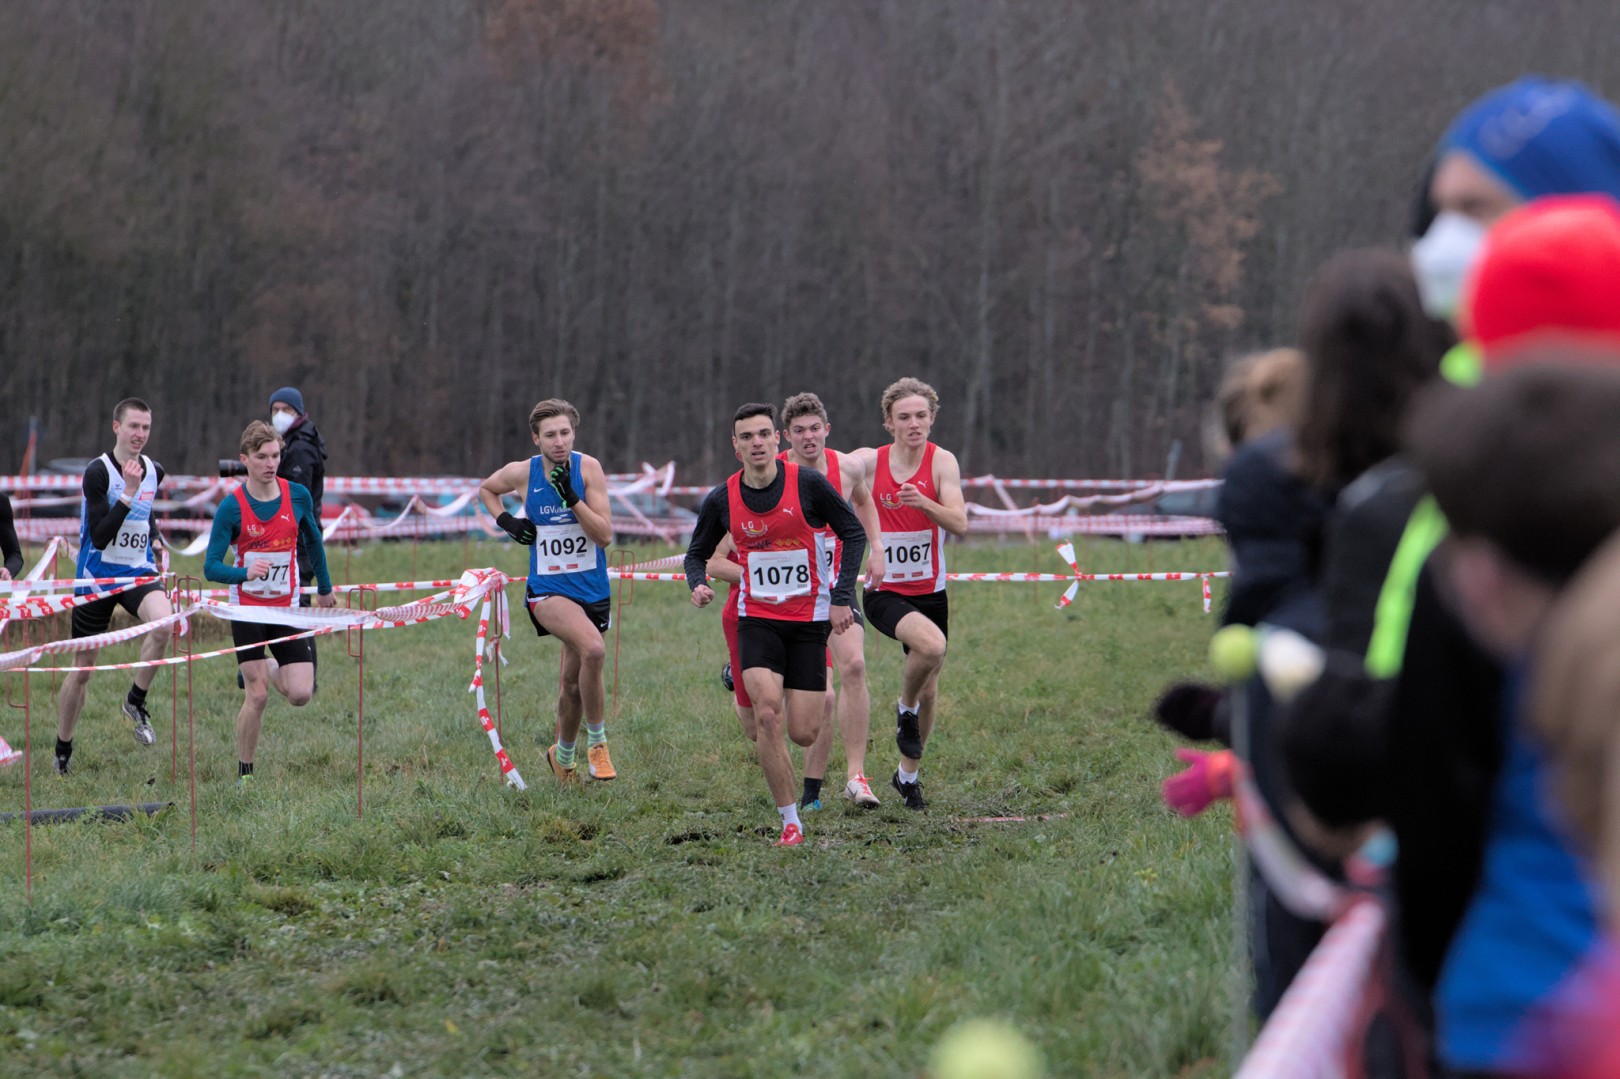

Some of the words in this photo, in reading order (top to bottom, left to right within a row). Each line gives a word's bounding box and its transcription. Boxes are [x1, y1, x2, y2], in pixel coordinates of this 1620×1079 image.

[540, 537, 587, 556] 1092
[884, 543, 931, 564] 1067
[754, 565, 809, 586] 1078
